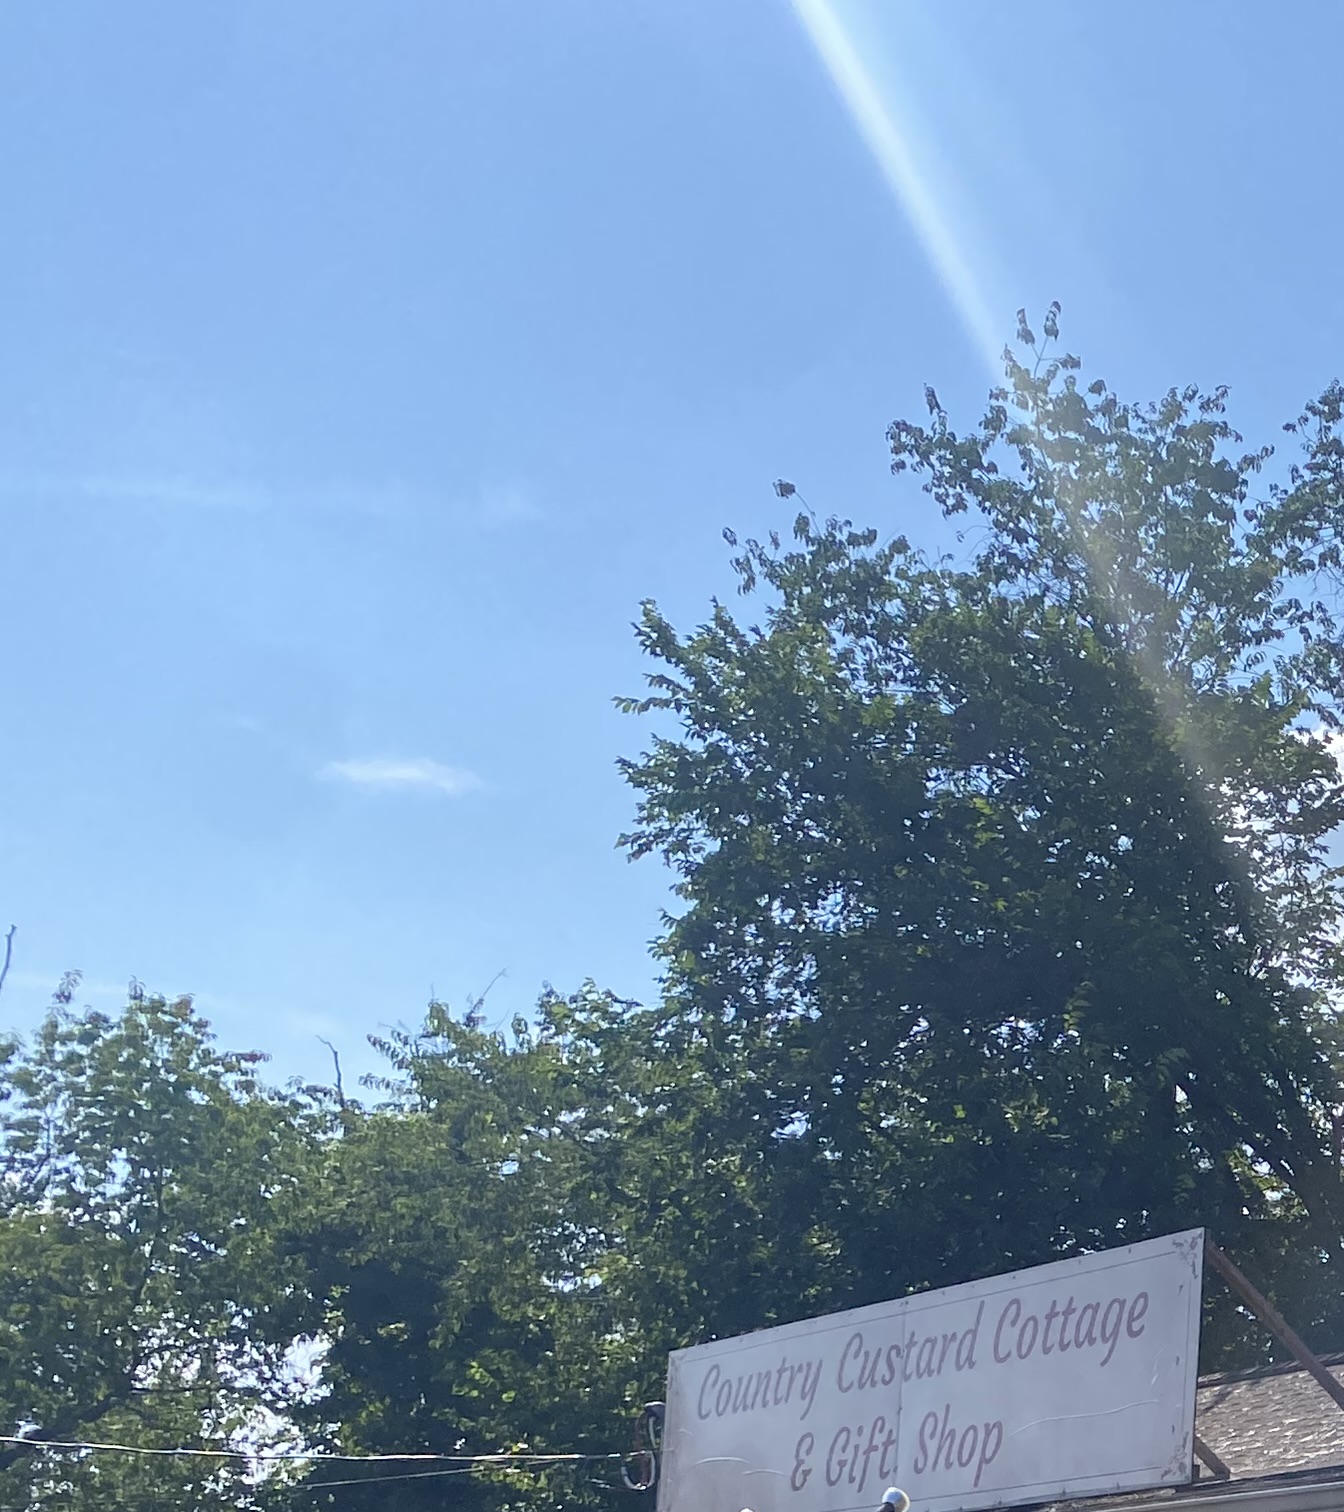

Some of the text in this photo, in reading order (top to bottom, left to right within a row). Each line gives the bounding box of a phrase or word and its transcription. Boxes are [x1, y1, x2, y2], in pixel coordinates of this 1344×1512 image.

[697, 1291, 1149, 1421] Country Custard Cottage
[790, 1403, 1003, 1493] & Gift Shop
